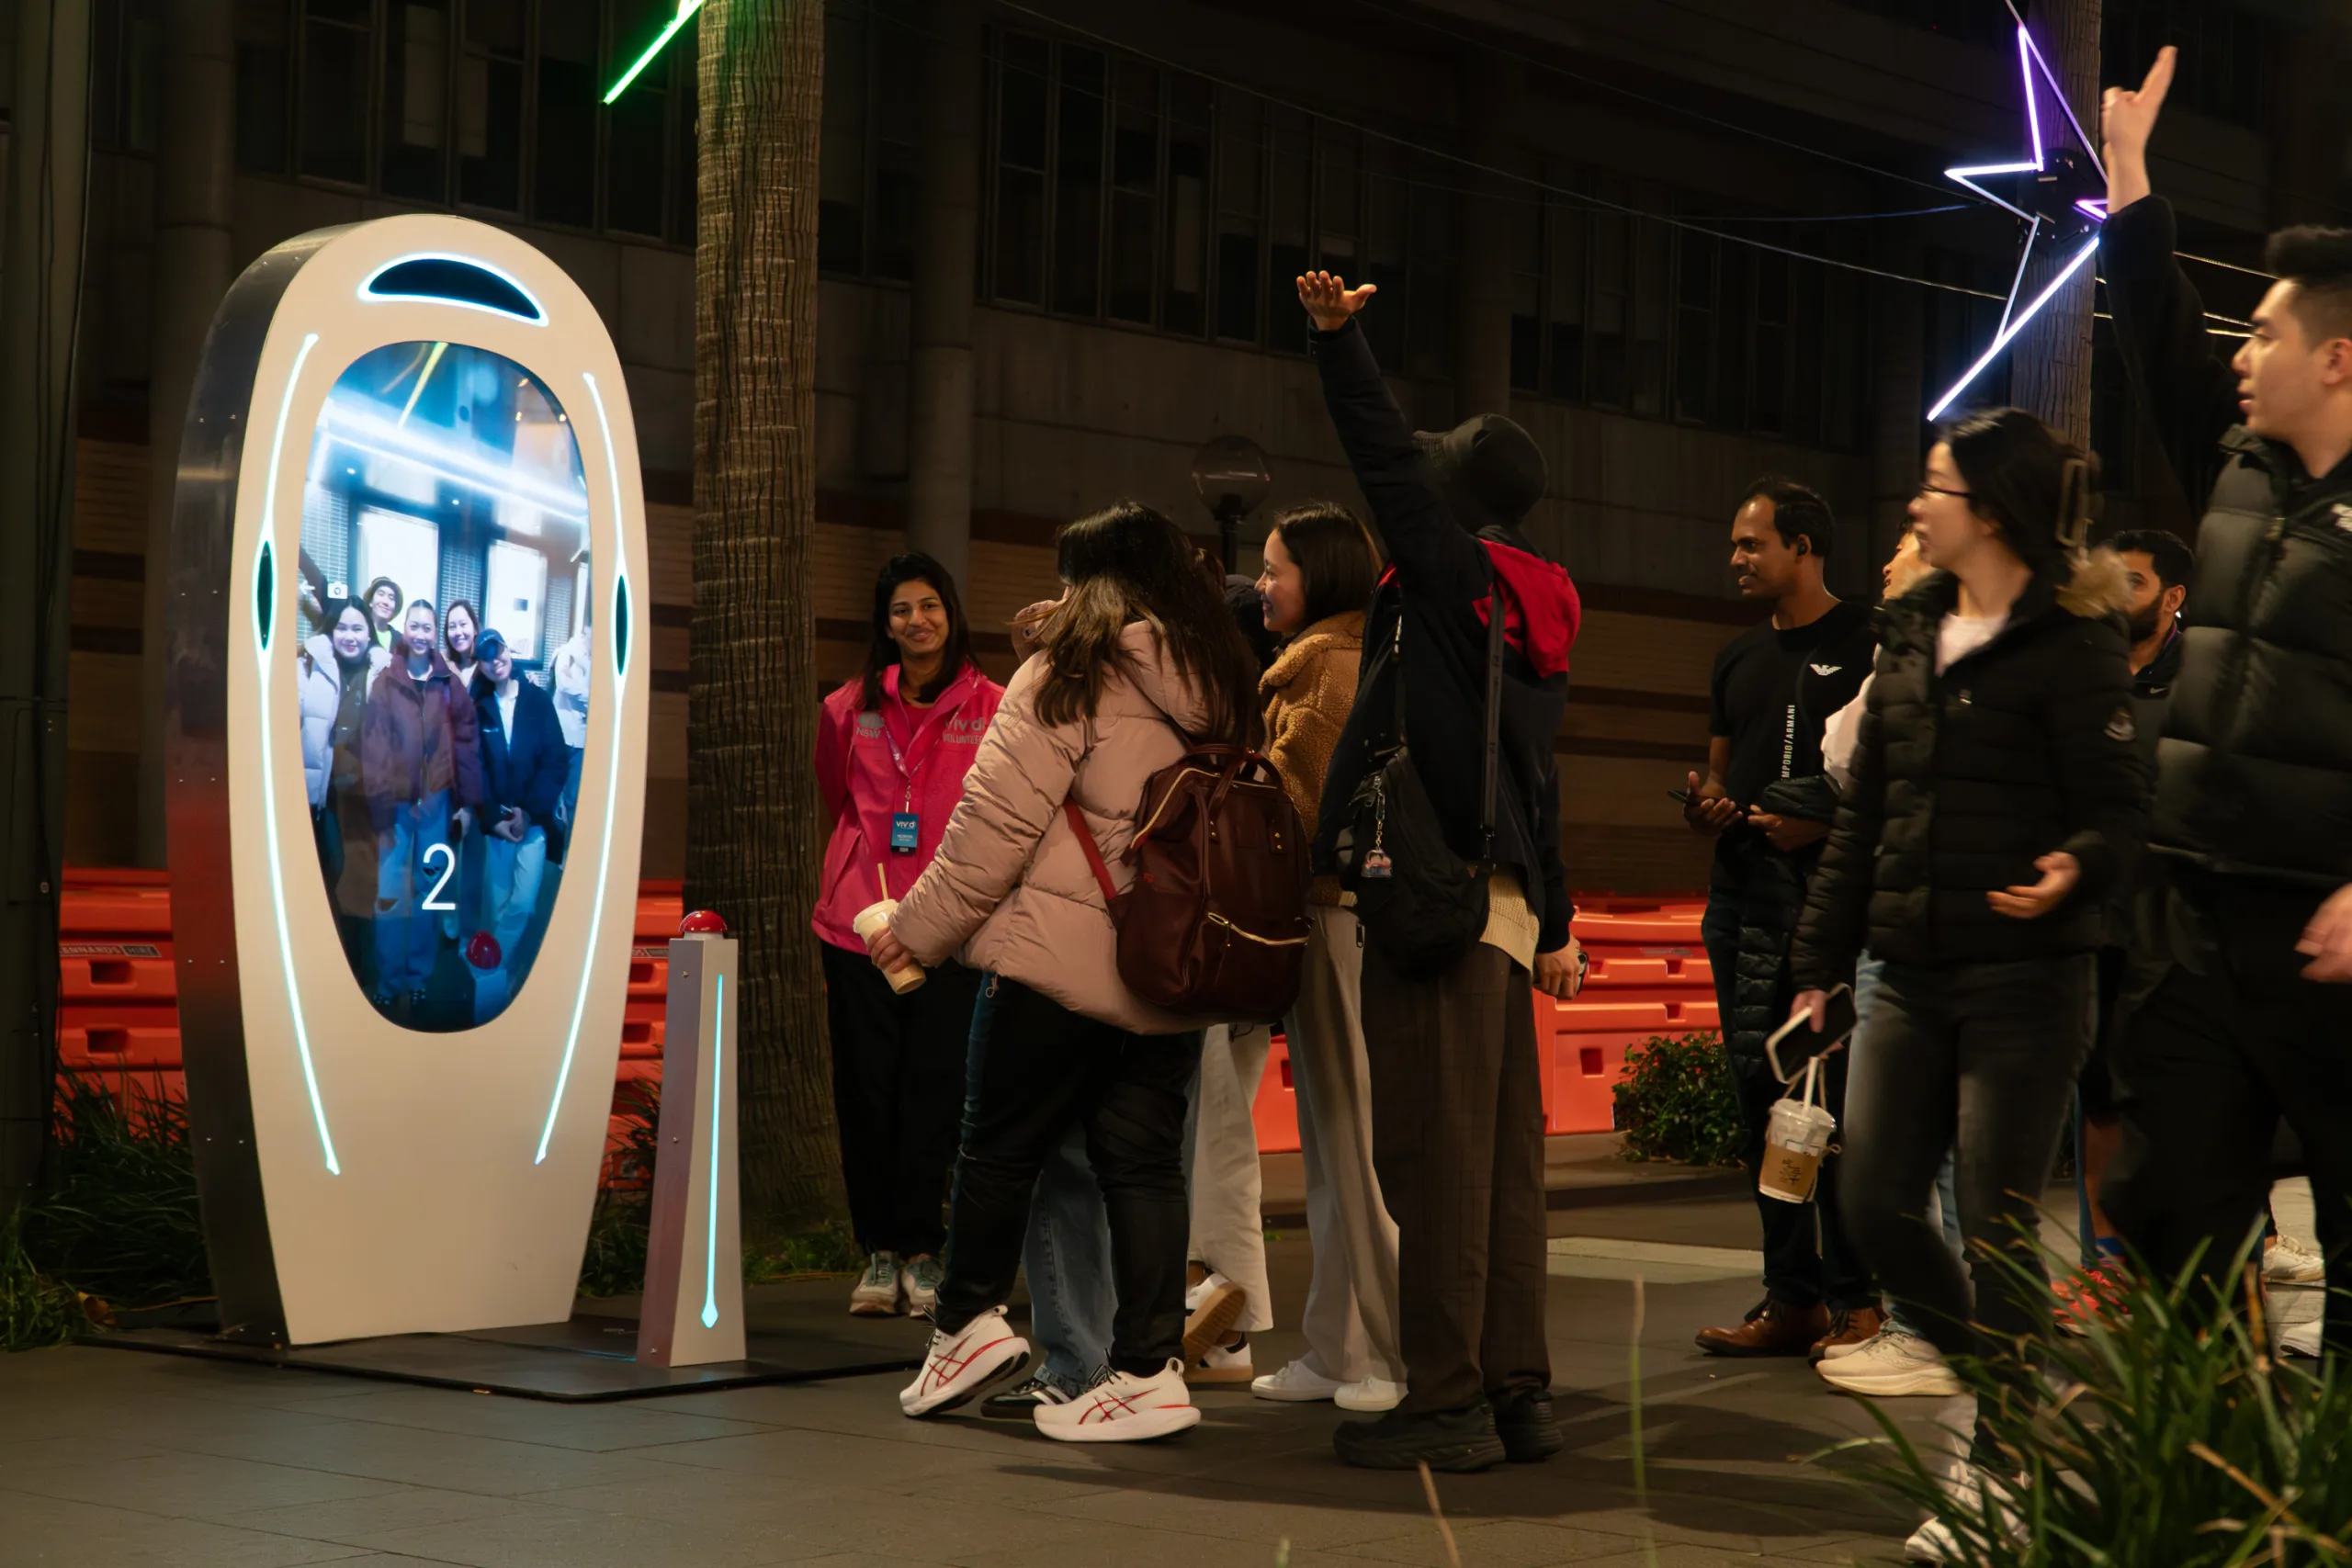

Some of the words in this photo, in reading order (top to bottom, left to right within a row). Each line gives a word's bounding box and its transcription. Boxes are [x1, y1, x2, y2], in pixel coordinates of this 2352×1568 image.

[855, 727, 882, 739] NSW
[1781, 705, 1795, 780] MPORIO/ARMANI
[422, 842, 456, 910] 2
